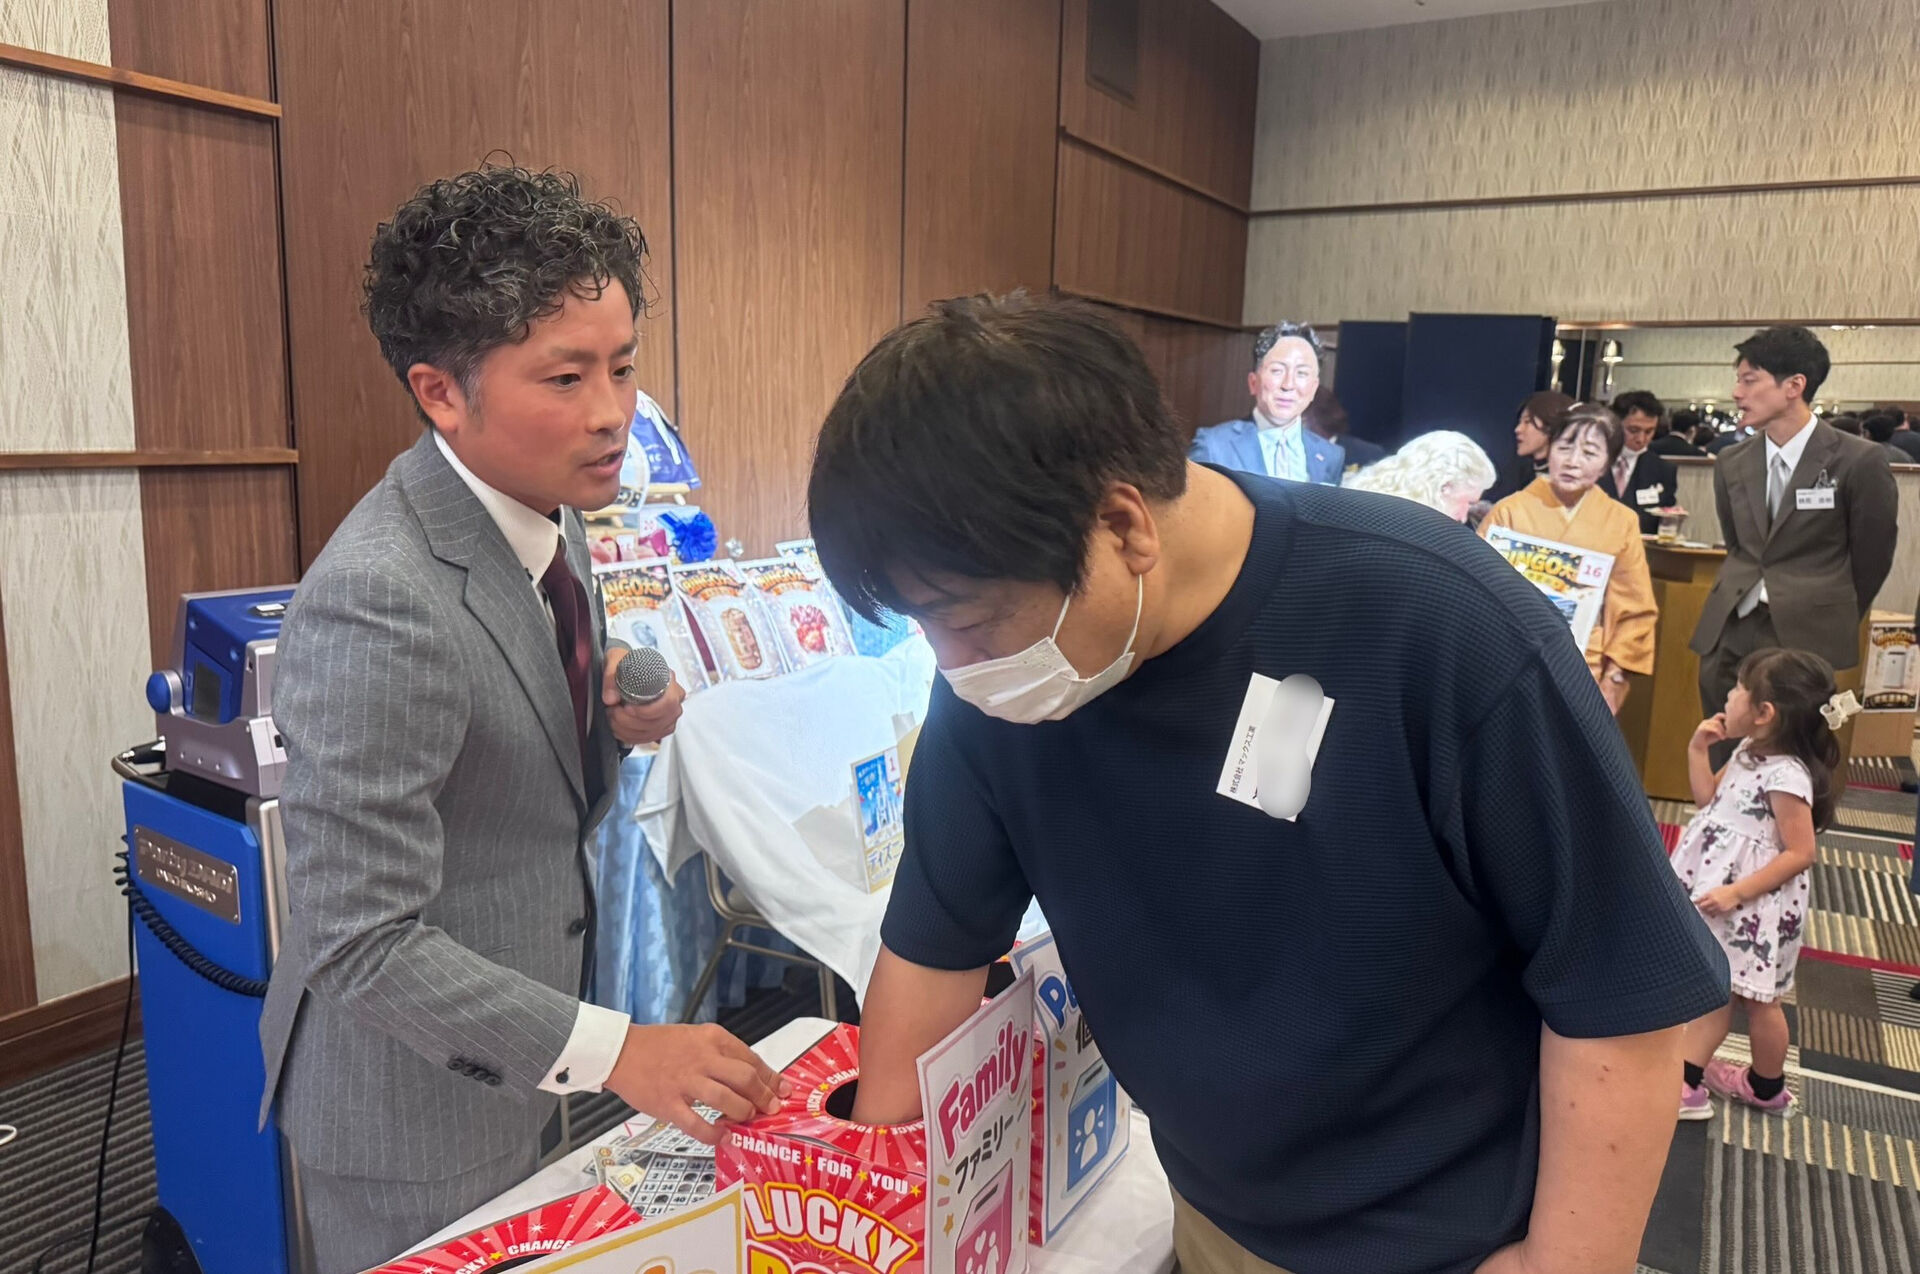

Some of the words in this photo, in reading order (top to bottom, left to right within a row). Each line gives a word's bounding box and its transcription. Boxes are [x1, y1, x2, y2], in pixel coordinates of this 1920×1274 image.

[1584, 564, 1603, 578] 16
[889, 757, 896, 772] 1
[937, 1020, 1028, 1159] Family
[731, 1132, 801, 1165] CHANCE
[817, 1157, 853, 1180] FOR
[869, 1171, 909, 1195] YOU
[955, 1114, 1014, 1194] ファミリー
[744, 1186, 912, 1274] LUCKY
